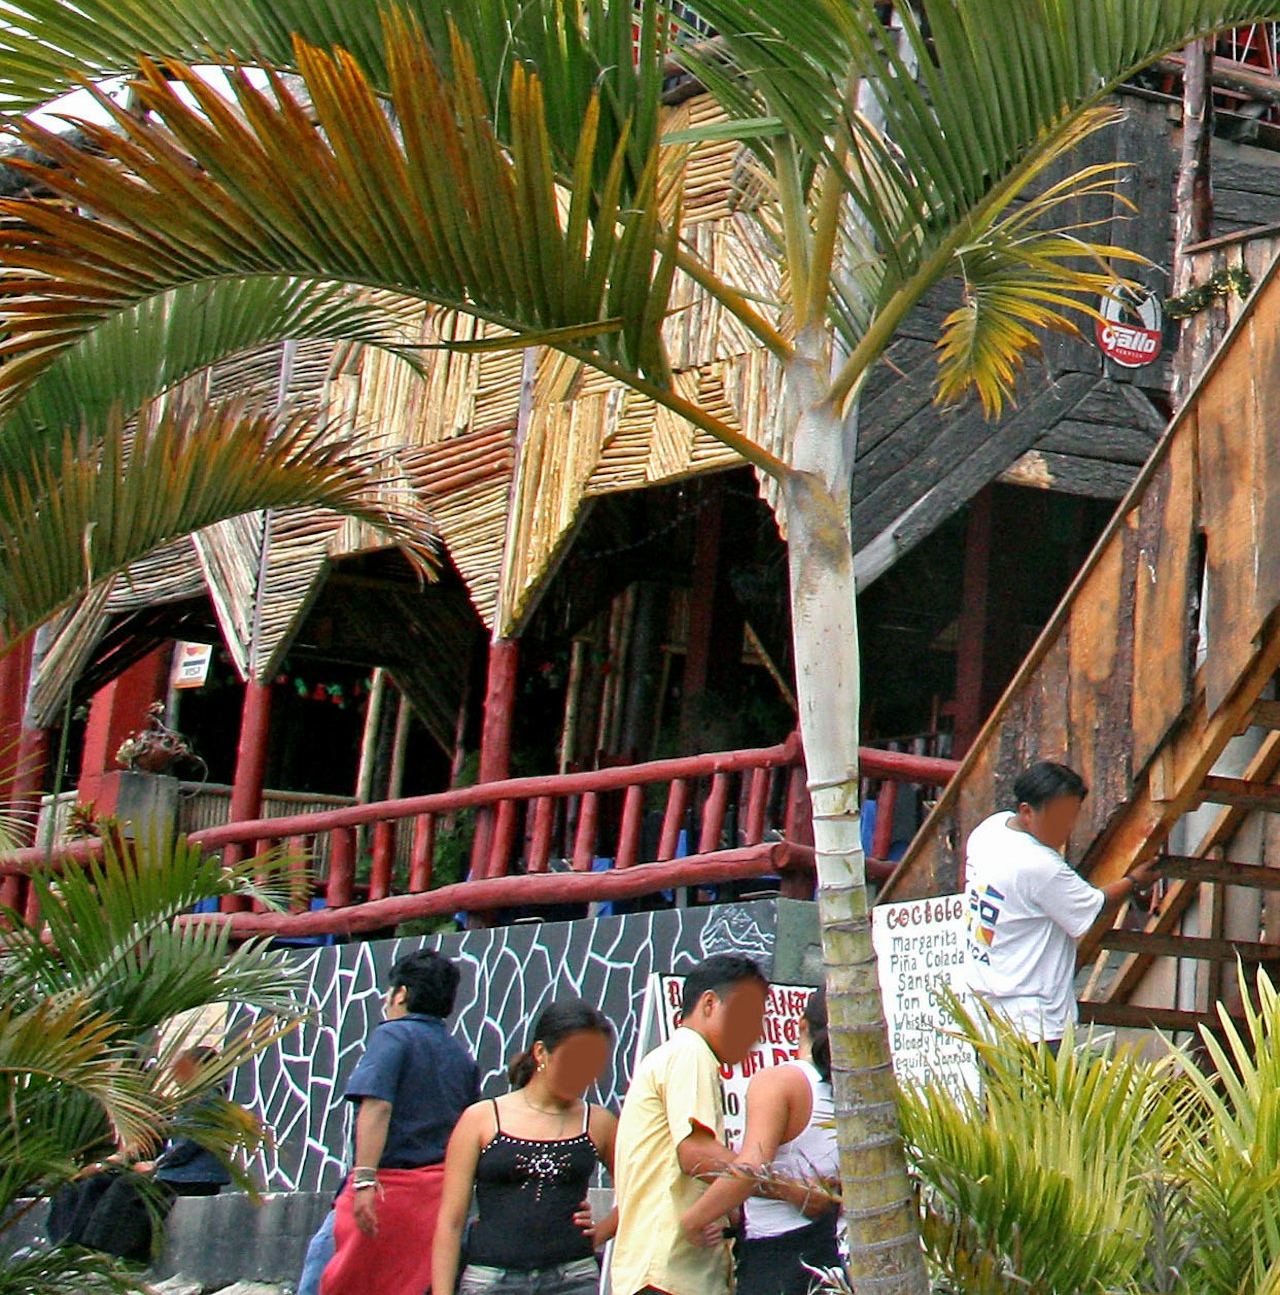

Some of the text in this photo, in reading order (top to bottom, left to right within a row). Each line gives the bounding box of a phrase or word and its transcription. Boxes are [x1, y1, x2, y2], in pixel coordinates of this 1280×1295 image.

[1102, 325, 1156, 353] Gallo
[890, 953, 917, 973] Piña
[926, 948, 965, 968] Colada
[896, 992, 920, 1011] Tom
